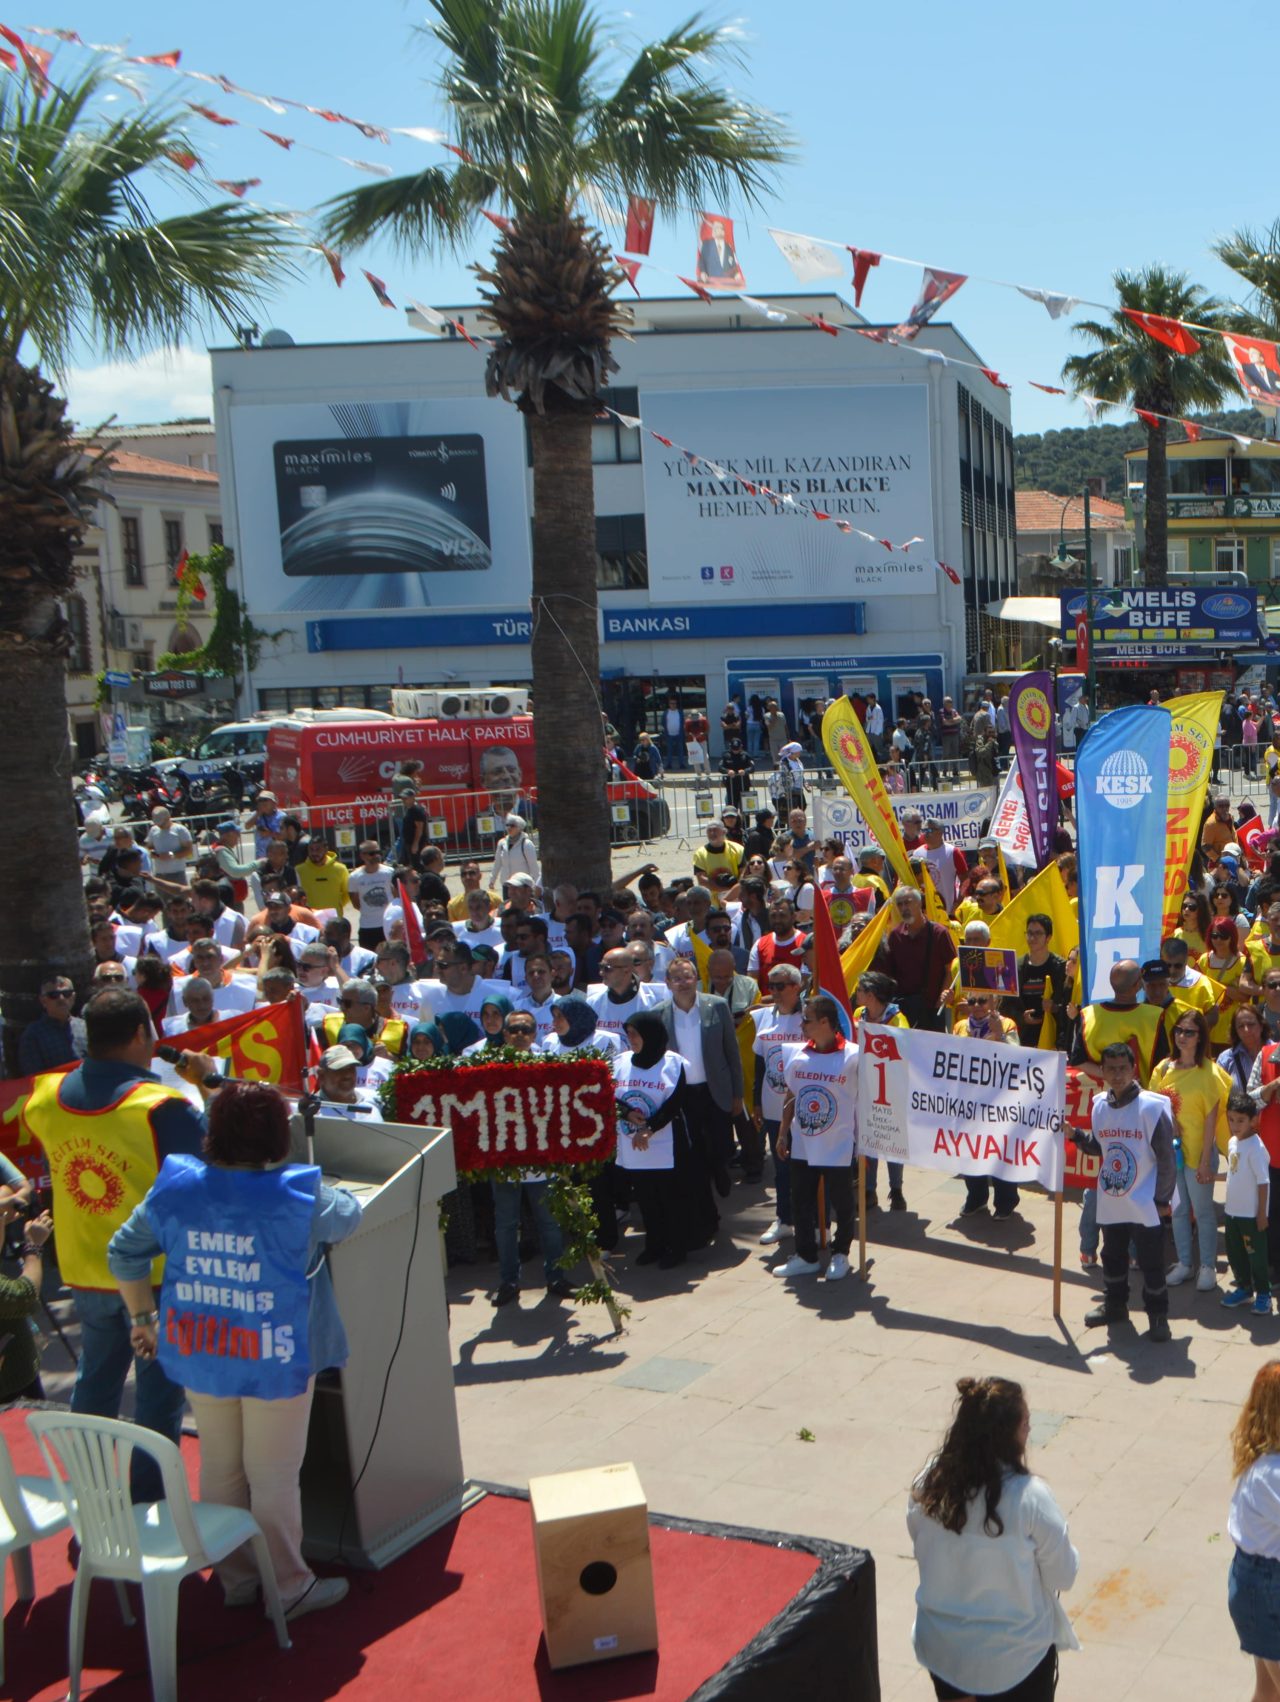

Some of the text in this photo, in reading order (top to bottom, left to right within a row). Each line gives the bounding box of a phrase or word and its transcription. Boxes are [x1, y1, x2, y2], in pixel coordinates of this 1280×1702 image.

[285, 448, 373, 465] maximiles
[745, 455, 780, 473] MİL
[785, 454, 912, 474] KAZANDIRAN
[806, 476, 891, 494] BLACK'E
[699, 500, 771, 518] HEMEN
[440, 540, 485, 555] VISA
[855, 561, 924, 575] maximiles
[609, 616, 690, 634] BANKASI
[1128, 610, 1191, 627] BÜFE
[810, 659, 858, 668] Bankamatik
[316, 727, 424, 746] CUMHURİYET
[428, 727, 470, 743] HALK
[475, 723, 531, 740] PARTİSİ
[1096, 776, 1153, 794] KESK
[1163, 806, 1190, 897] SEN
[873, 1061, 892, 1107] 1
[932, 1050, 1045, 1099] BELEDİYE-İŞ
[440, 1082, 605, 1152] MAYIS
[911, 1090, 1065, 1133] SENDİKASI TEMSİLCİLİĞİ
[51, 1134, 133, 1176] EĞİTİM SEN
[933, 1128, 1041, 1166] AYVALIK
[187, 1229, 256, 1256] EMEK
[185, 1255, 261, 1283] EYLEM
[175, 1280, 275, 1315] DİRENİŞ
